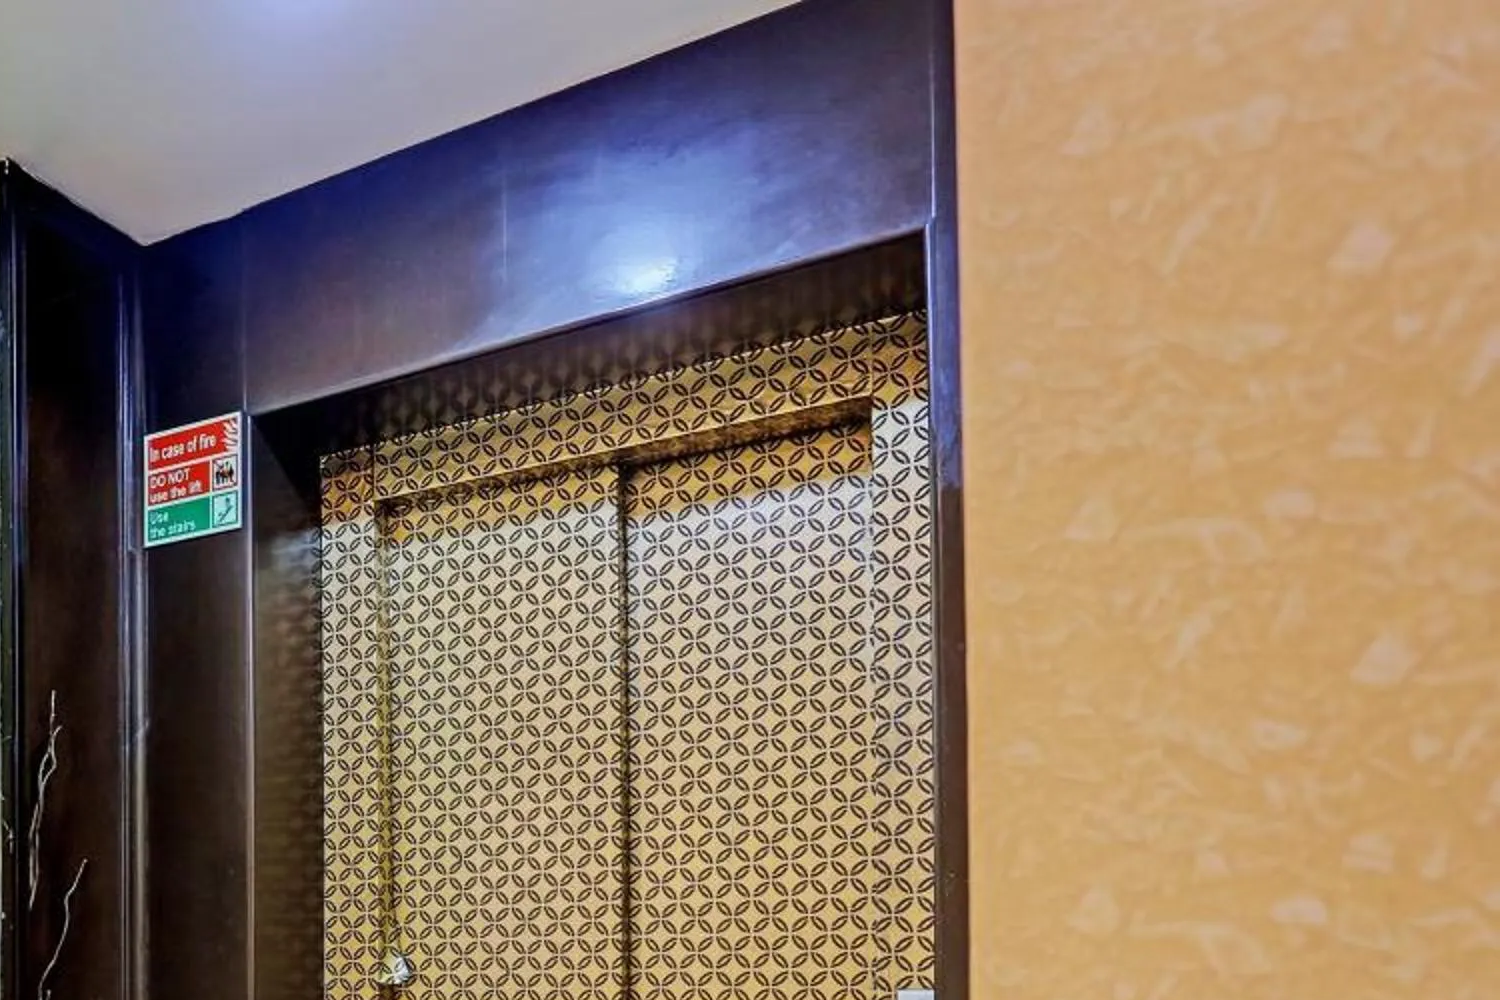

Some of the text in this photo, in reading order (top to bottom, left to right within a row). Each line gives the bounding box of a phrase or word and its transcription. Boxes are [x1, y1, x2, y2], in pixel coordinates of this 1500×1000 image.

[161, 443, 185, 460] case
[186, 435, 197, 453] of
[199, 433, 217, 451] fire
[150, 467, 191, 489] DO NOT
